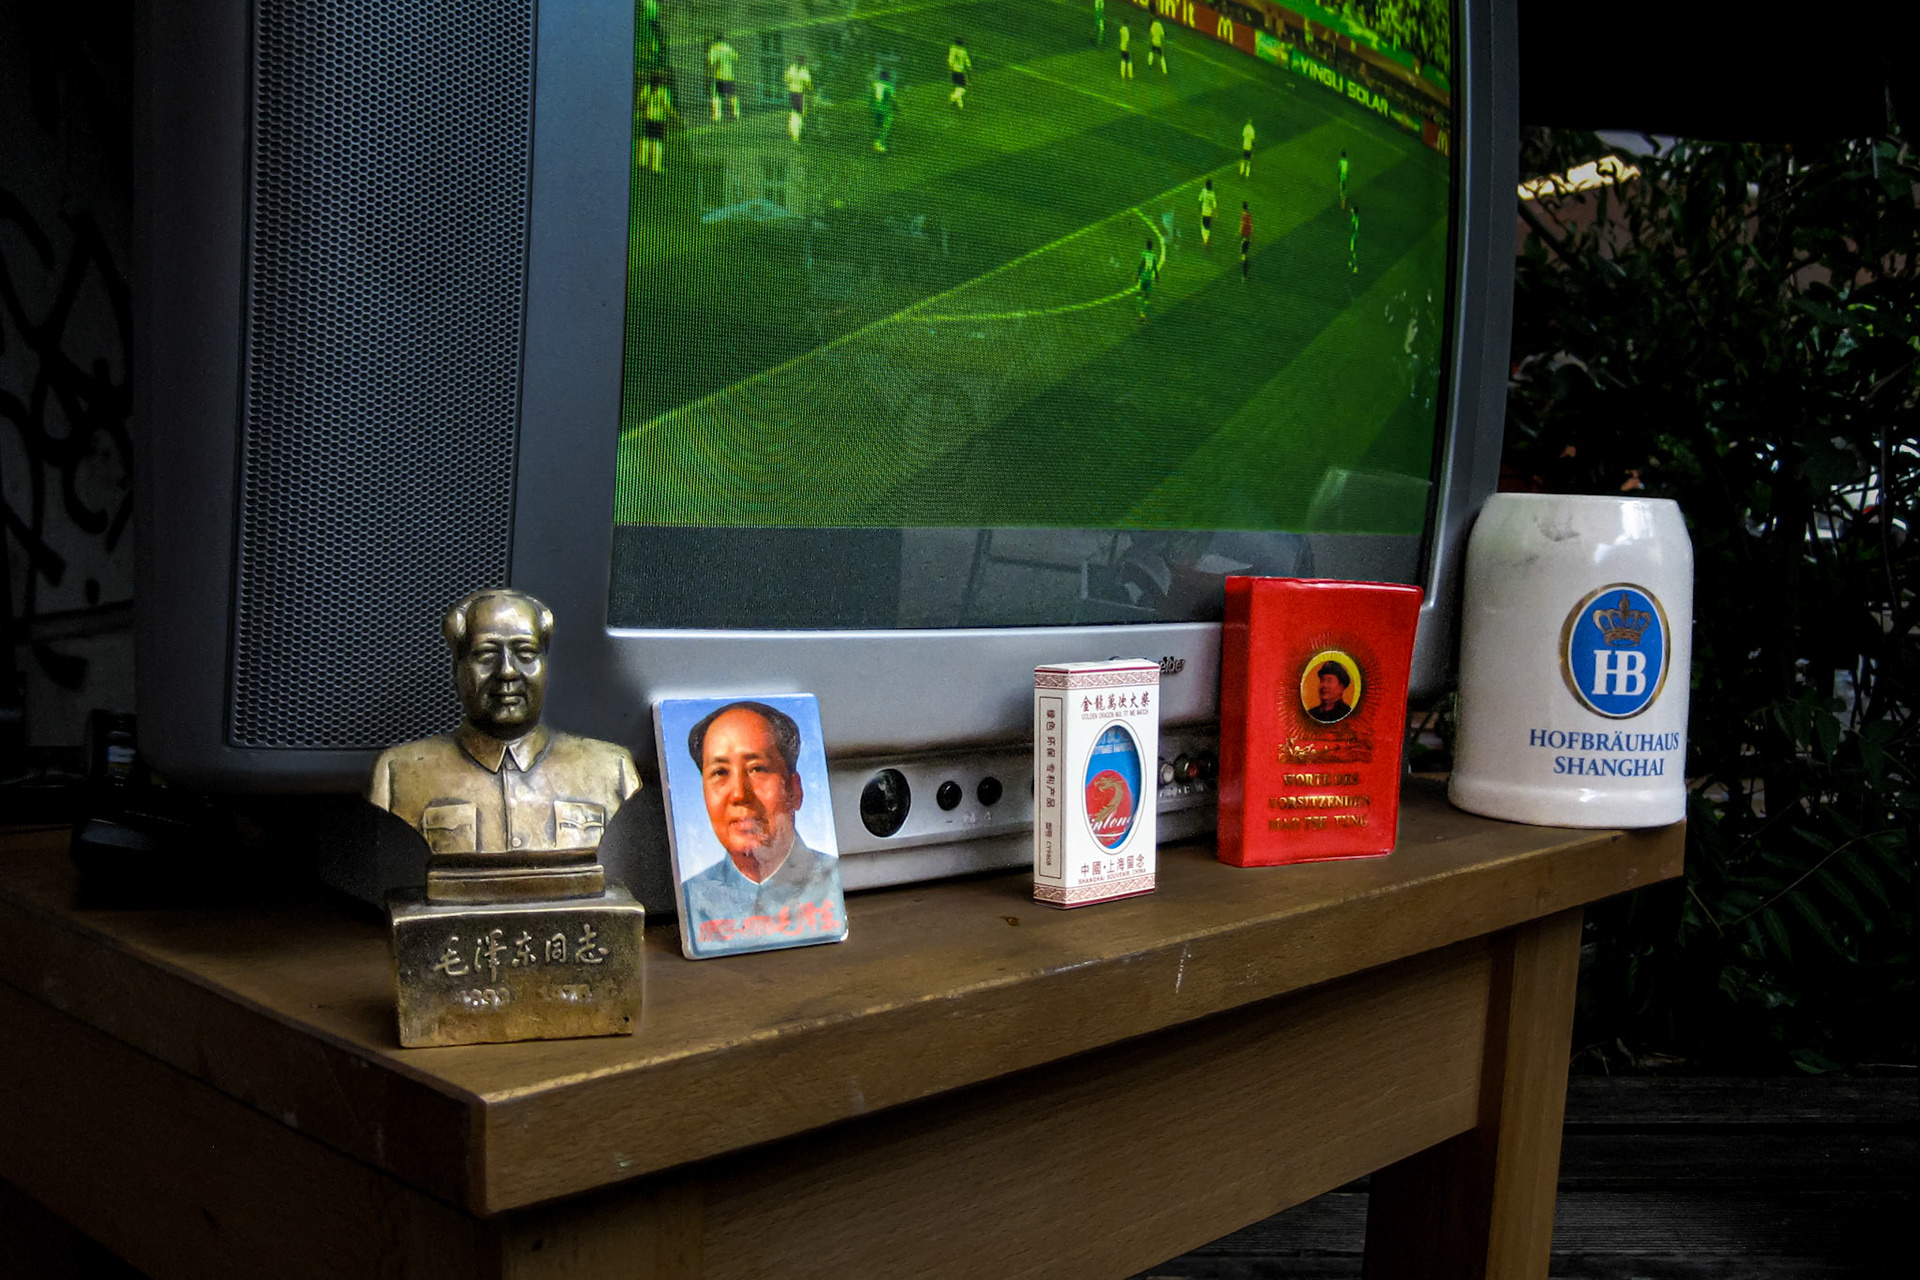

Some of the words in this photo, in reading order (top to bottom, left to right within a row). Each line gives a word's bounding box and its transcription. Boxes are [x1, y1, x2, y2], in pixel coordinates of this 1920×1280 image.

[1346, 80, 1389, 118] SOLAR
[1591, 649, 1647, 696] HB
[1099, 711, 1114, 719] DRAGON
[1529, 728, 1679, 752] HOFBRÄUHAUS
[1553, 755, 1665, 777] SHANGHAI
[1078, 875, 1105, 884] SHANGHAI
[1132, 867, 1146, 875] CHINA
